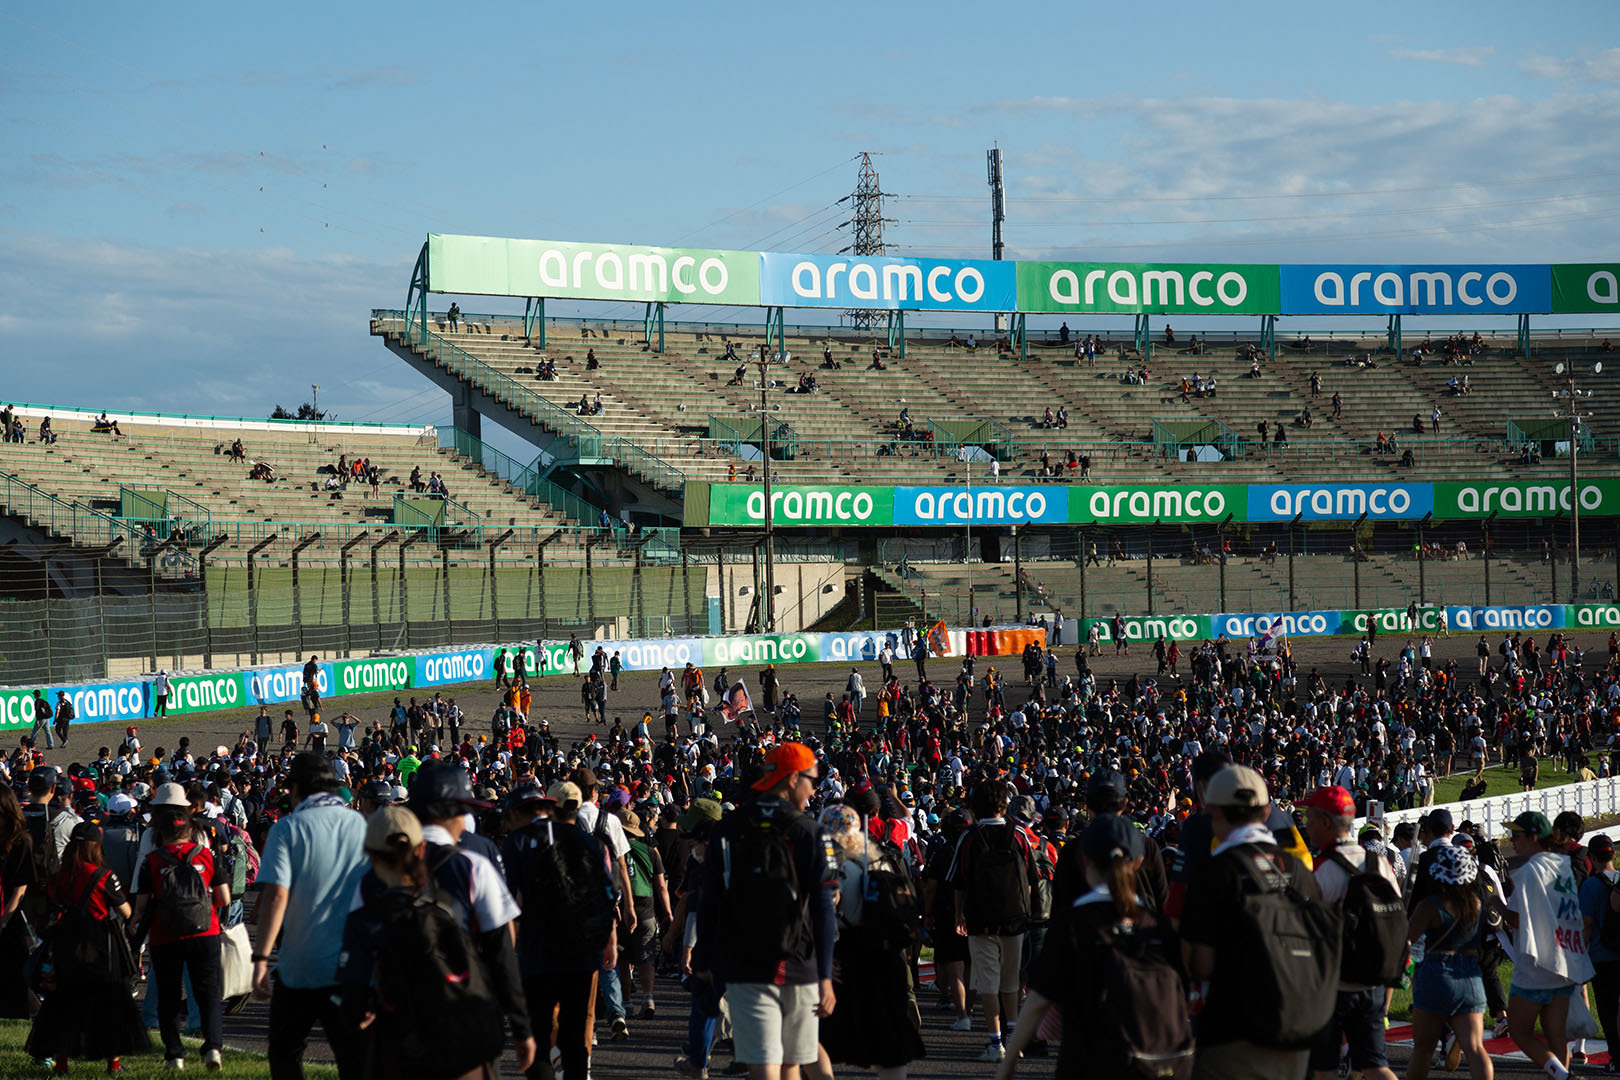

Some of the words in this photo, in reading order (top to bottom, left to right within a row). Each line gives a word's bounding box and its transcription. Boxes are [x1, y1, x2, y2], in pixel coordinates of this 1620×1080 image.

[539, 249, 729, 295] aramco
[791, 261, 985, 303] aramco
[1049, 269, 1248, 306] aramco
[1314, 271, 1518, 306] aramco
[747, 491, 874, 520] aramco
[915, 491, 1047, 519] aramco
[1090, 491, 1226, 518] aramco
[1271, 489, 1411, 515] aramco
[1458, 486, 1603, 512] aramco
[1099, 619, 1198, 640] aamco
[1456, 609, 1552, 628] aramco
[714, 638, 807, 662] aramco
[344, 662, 408, 690] aramco
[426, 654, 484, 682] aramco
[251, 668, 328, 699] aramo
[64, 687, 143, 719] ramco
